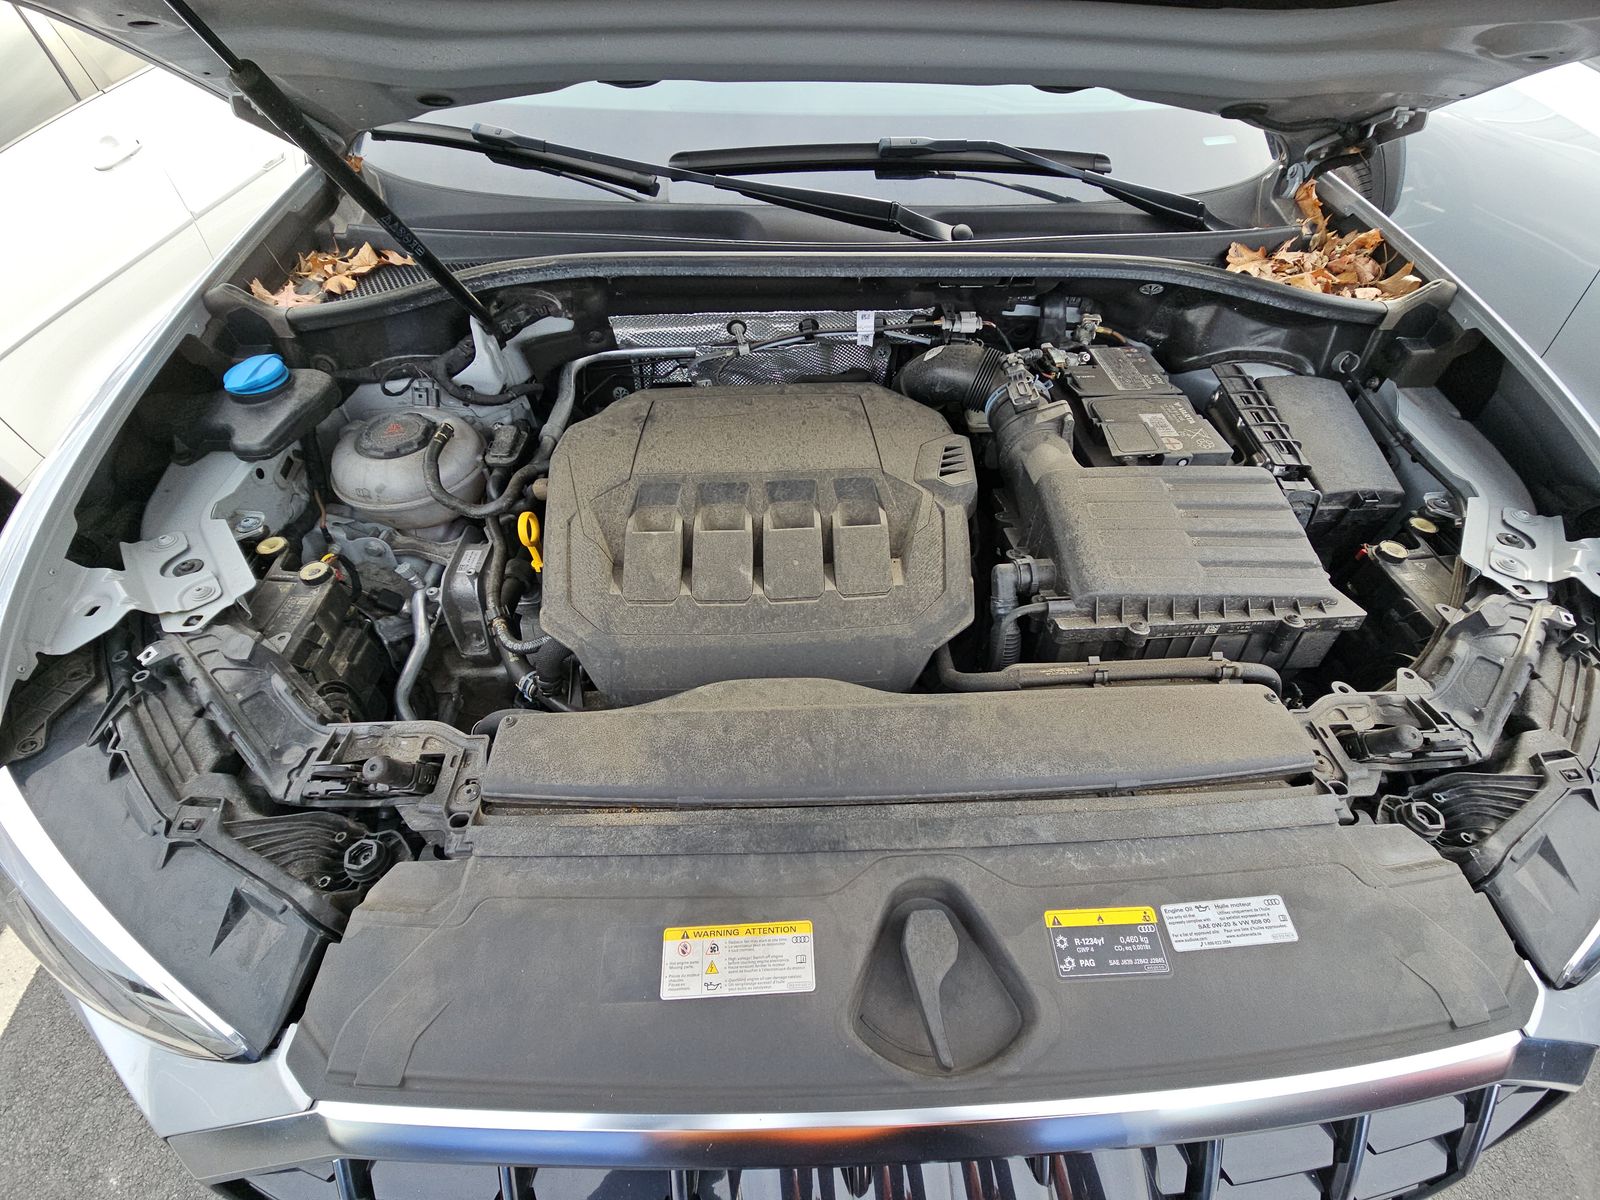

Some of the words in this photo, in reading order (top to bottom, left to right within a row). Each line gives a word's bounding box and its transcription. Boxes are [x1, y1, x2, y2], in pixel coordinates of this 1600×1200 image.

[693, 928, 740, 938] WARNING
[745, 925, 797, 935] ATTENTION
[1074, 937, 1105, 946] R-1234yf
[1139, 936, 1149, 944] kg
[1079, 959, 1096, 967] PAG
